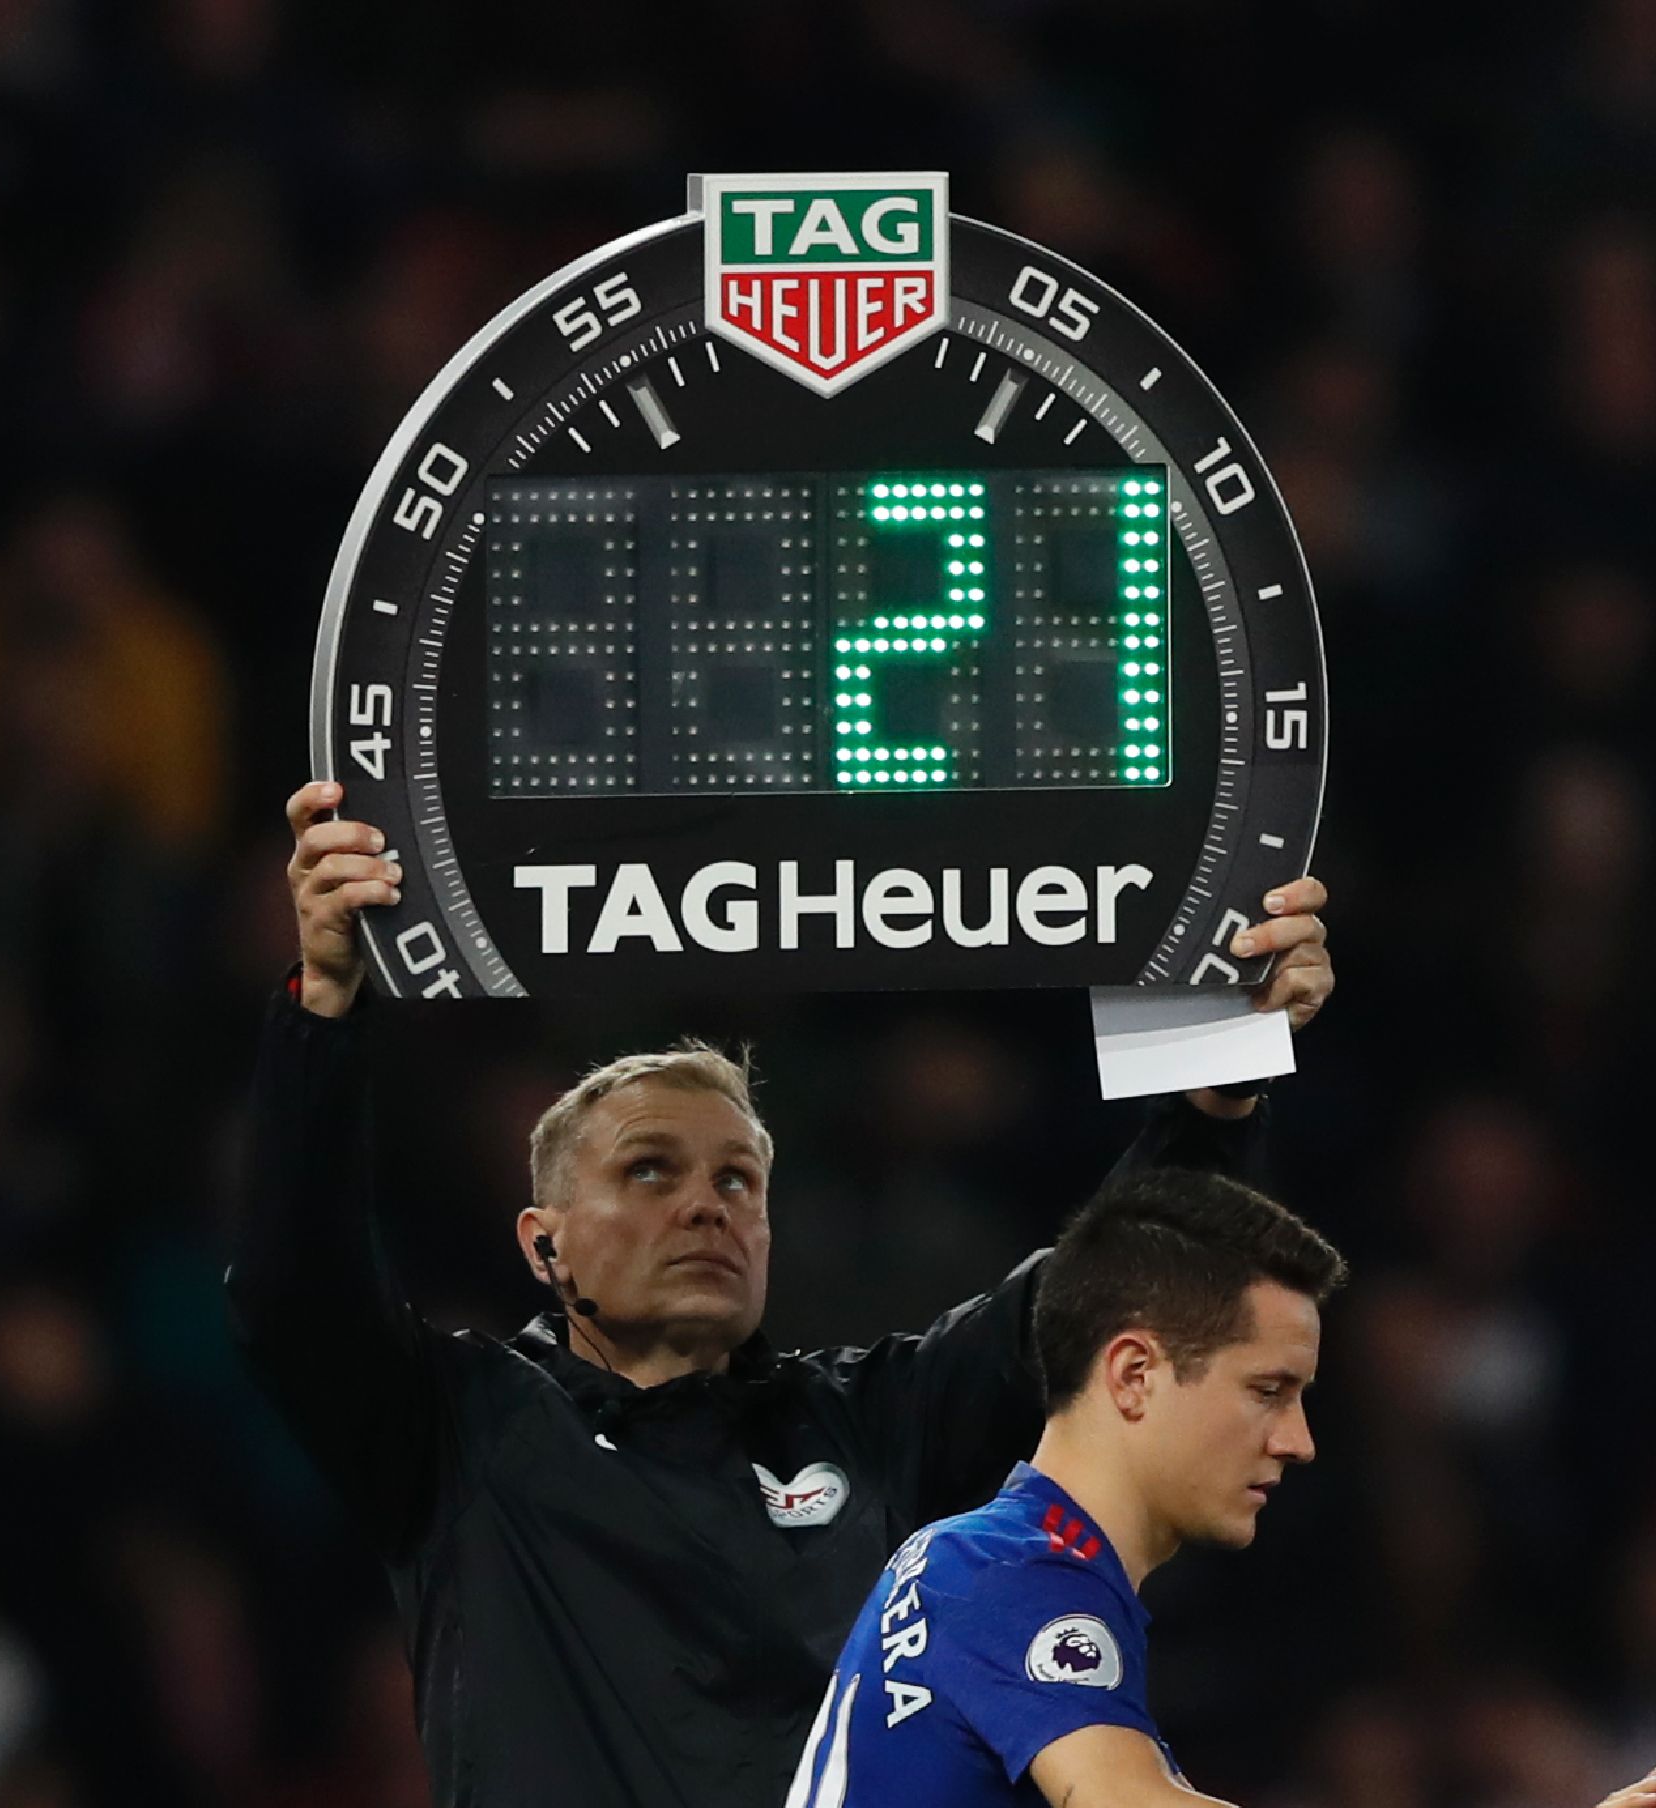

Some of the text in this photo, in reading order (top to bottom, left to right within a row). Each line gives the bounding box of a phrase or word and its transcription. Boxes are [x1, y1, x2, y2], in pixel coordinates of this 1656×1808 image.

[731, 197, 920, 255] TAG
[552, 271, 643, 352] 55
[728, 277, 928, 371] HEUER
[1008, 265, 1100, 341] 05
[393, 443, 469, 540] 50
[1194, 436, 1256, 515] 10
[833, 478, 1166, 788] 21
[349, 684, 393, 780] 45
[1264, 682, 1308, 750] 15
